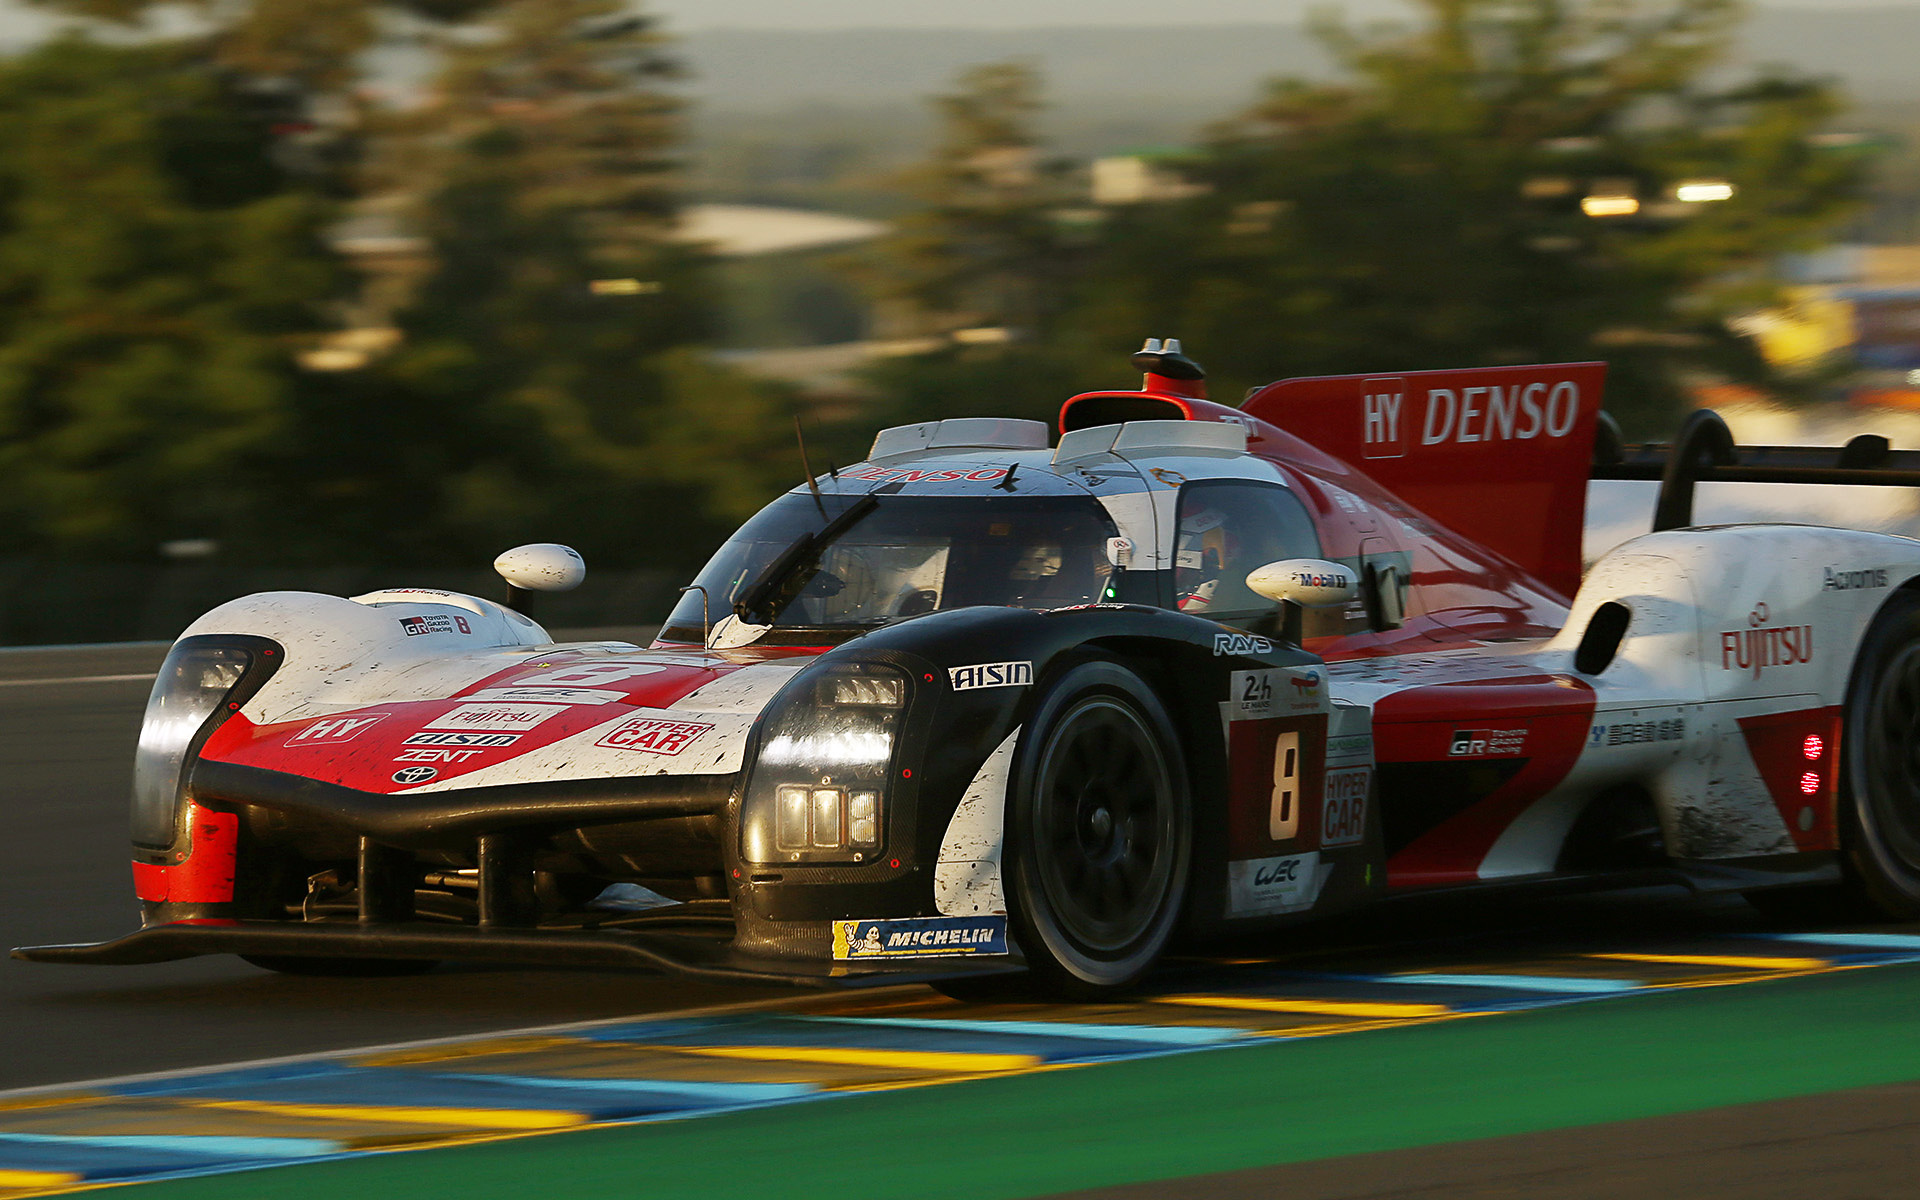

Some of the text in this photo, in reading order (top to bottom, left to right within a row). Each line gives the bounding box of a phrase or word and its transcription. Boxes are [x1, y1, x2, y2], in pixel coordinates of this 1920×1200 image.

[1364, 393, 1403, 443] HY
[1421, 380, 1580, 446] DENSO
[840, 467, 1008, 482] DENSO
[404, 622, 429, 635] GR
[429, 626, 453, 634] Racing
[453, 615, 472, 635] 8
[1213, 633, 1272, 656] RAYS
[1720, 625, 1813, 681] FUJITSU
[955, 663, 1031, 689] AISIN
[451, 710, 540, 724] FUJITSU
[624, 720, 705, 735] HYPER
[295, 717, 379, 741] HY
[406, 733, 517, 746] AISIN
[607, 729, 690, 752] CAR
[392, 749, 483, 763] ZENT
[1450, 739, 1487, 755] GR
[1269, 731, 1299, 840] 8
[1327, 772, 1367, 798] HYPER
[1325, 798, 1364, 839] CAR
[1254, 859, 1300, 886] WEC
[887, 928, 995, 947] MICHELIN
